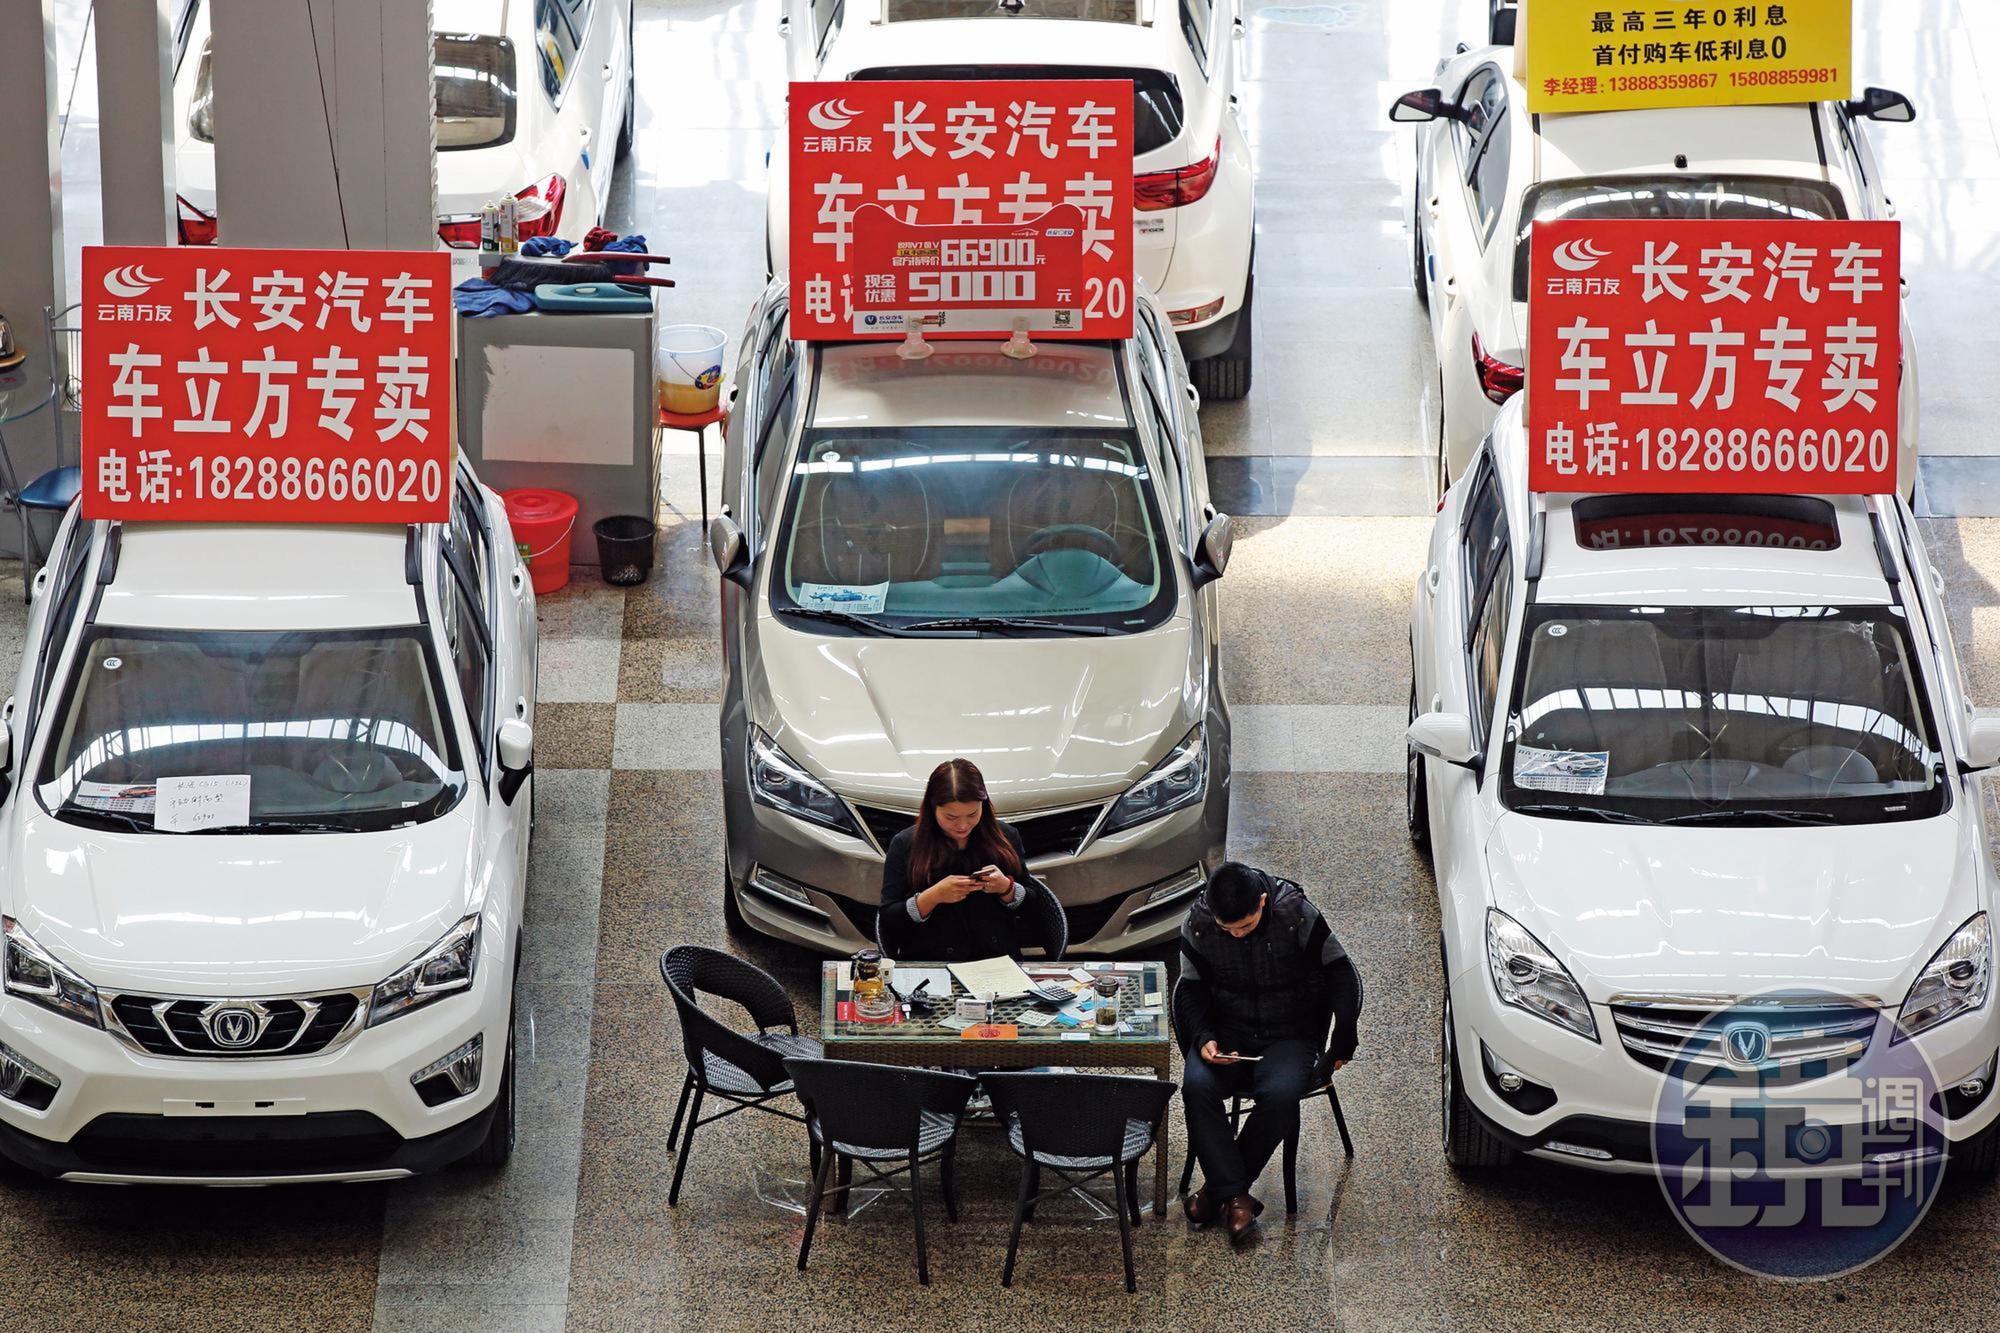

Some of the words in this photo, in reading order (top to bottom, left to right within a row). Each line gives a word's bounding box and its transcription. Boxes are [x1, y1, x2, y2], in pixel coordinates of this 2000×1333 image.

[1592, 5, 1787, 33] 最高三年0利息
[1593, 36, 1787, 66] 首付购车低利息0
[1729, 68, 1838, 87] 15808859981
[803, 136, 873, 153] 云南万友
[883, 101, 1118, 160] 长安汽车
[864, 274, 896, 288] 现金
[908, 271, 1036, 302] 5000
[1056, 288, 1072, 302] 元
[1547, 277, 1620, 295] 云南万友
[1631, 240, 1884, 304] 长安汽车
[183, 268, 434, 334] 长安汽车
[864, 289, 896, 303] 优惠
[97, 304, 172, 322] 云南万友
[1555, 316, 1879, 414] 车立方专卖
[107, 342, 431, 443] 车立方专卖
[1545, 421, 1889, 476] 电话:18288666020
[98, 448, 442, 504] 电话:18288666020
